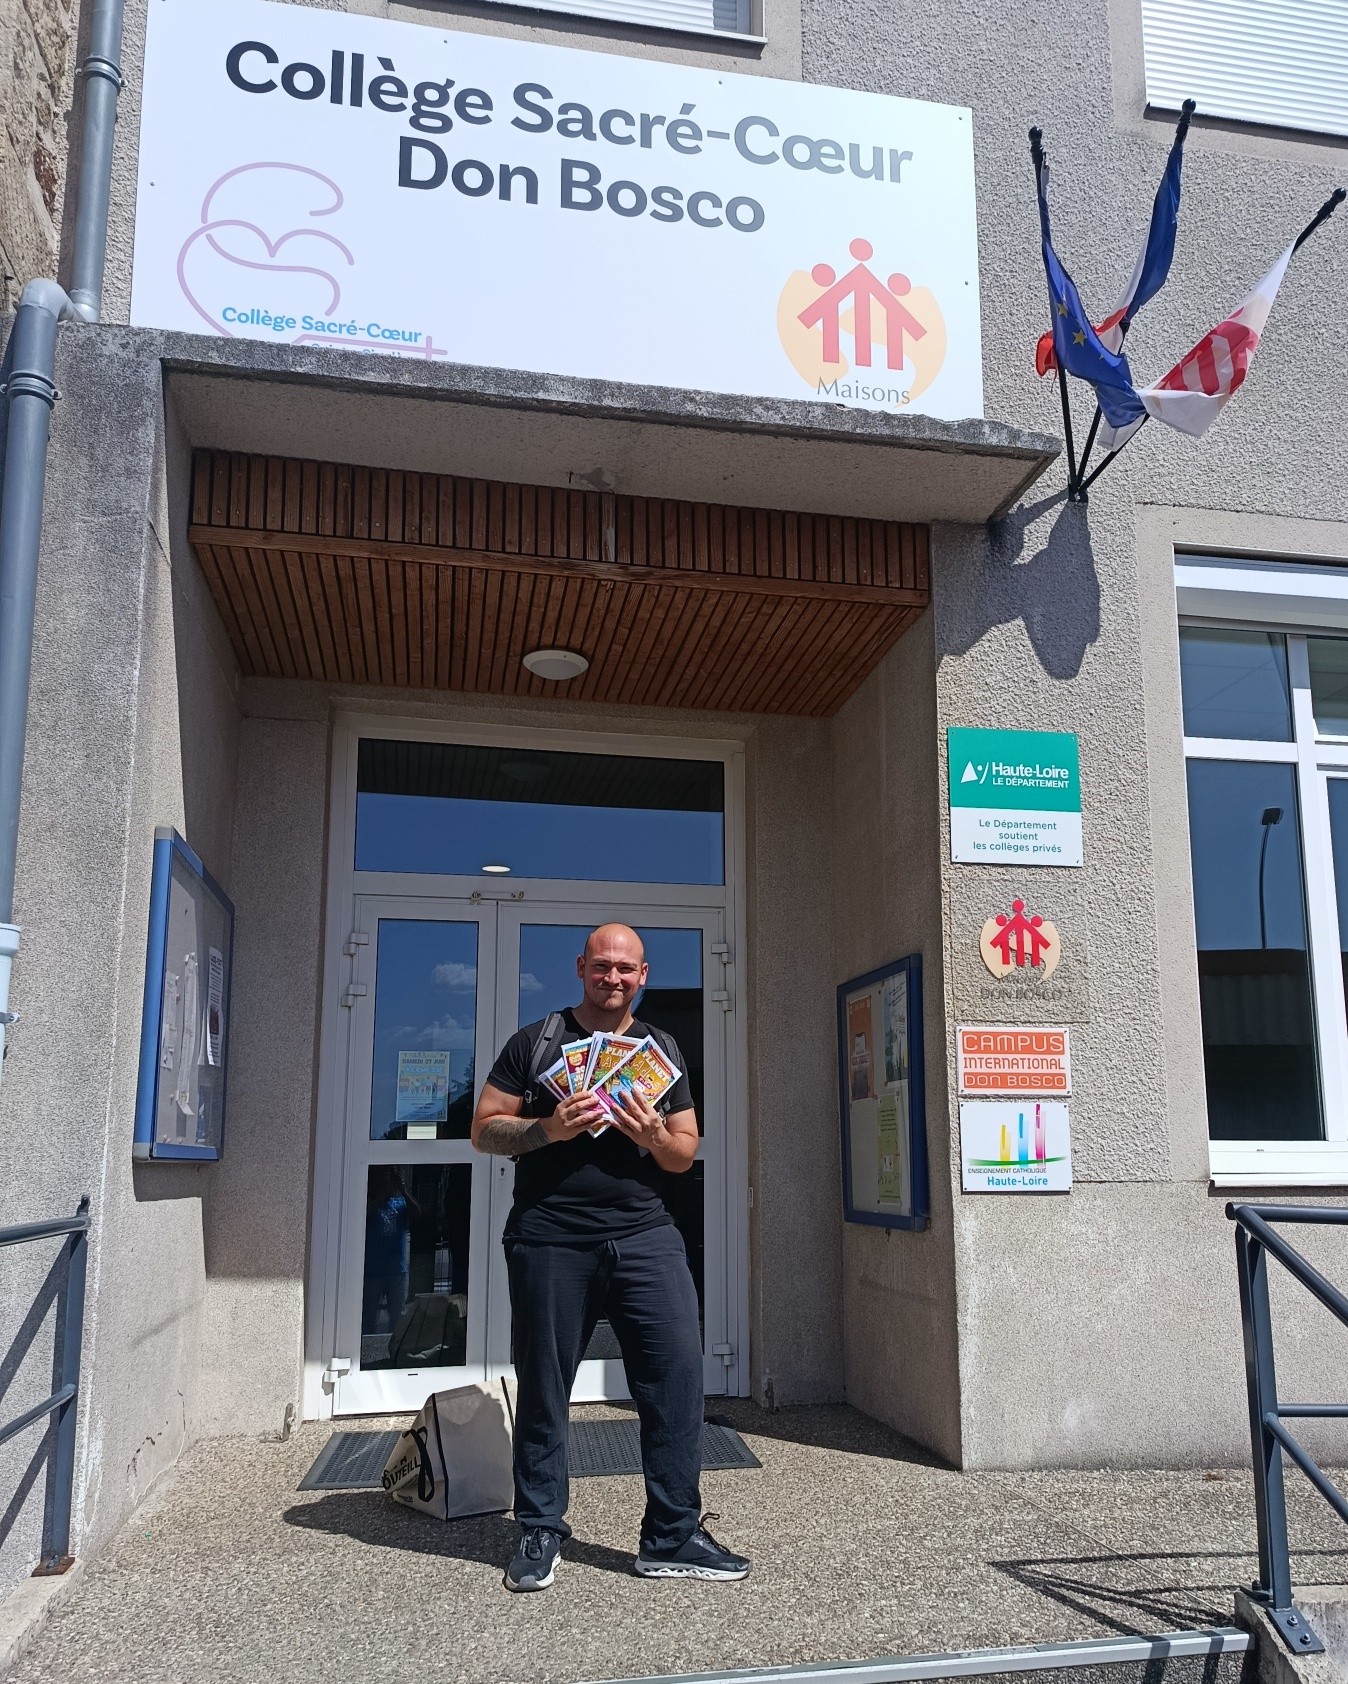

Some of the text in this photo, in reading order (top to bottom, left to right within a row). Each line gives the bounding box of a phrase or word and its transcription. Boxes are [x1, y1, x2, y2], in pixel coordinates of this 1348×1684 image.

[225, 40, 913, 183] Collège Sacré-Cœur
[398, 136, 765, 233] Don Bosco
[221, 306, 422, 343] Collège Sacré-Cœur
[816, 377, 910, 405] Maisons
[991, 762, 1069, 779] Haute-Loire
[992, 777, 1070, 788] LE DÉPARTEMENT
[979, 819, 1057, 830] Le Département
[998, 832, 1038, 841] soutient
[973, 841, 1062, 853] les collèges privés
[963, 1034, 1064, 1052] CAMPUS
[641, 1051, 669, 1082] PLANET
[963, 1057, 1065, 1070] INTERNATIONAL
[964, 1075, 1066, 1087] DON BOSCO
[987, 1176, 1049, 1186] Haute-Loire
